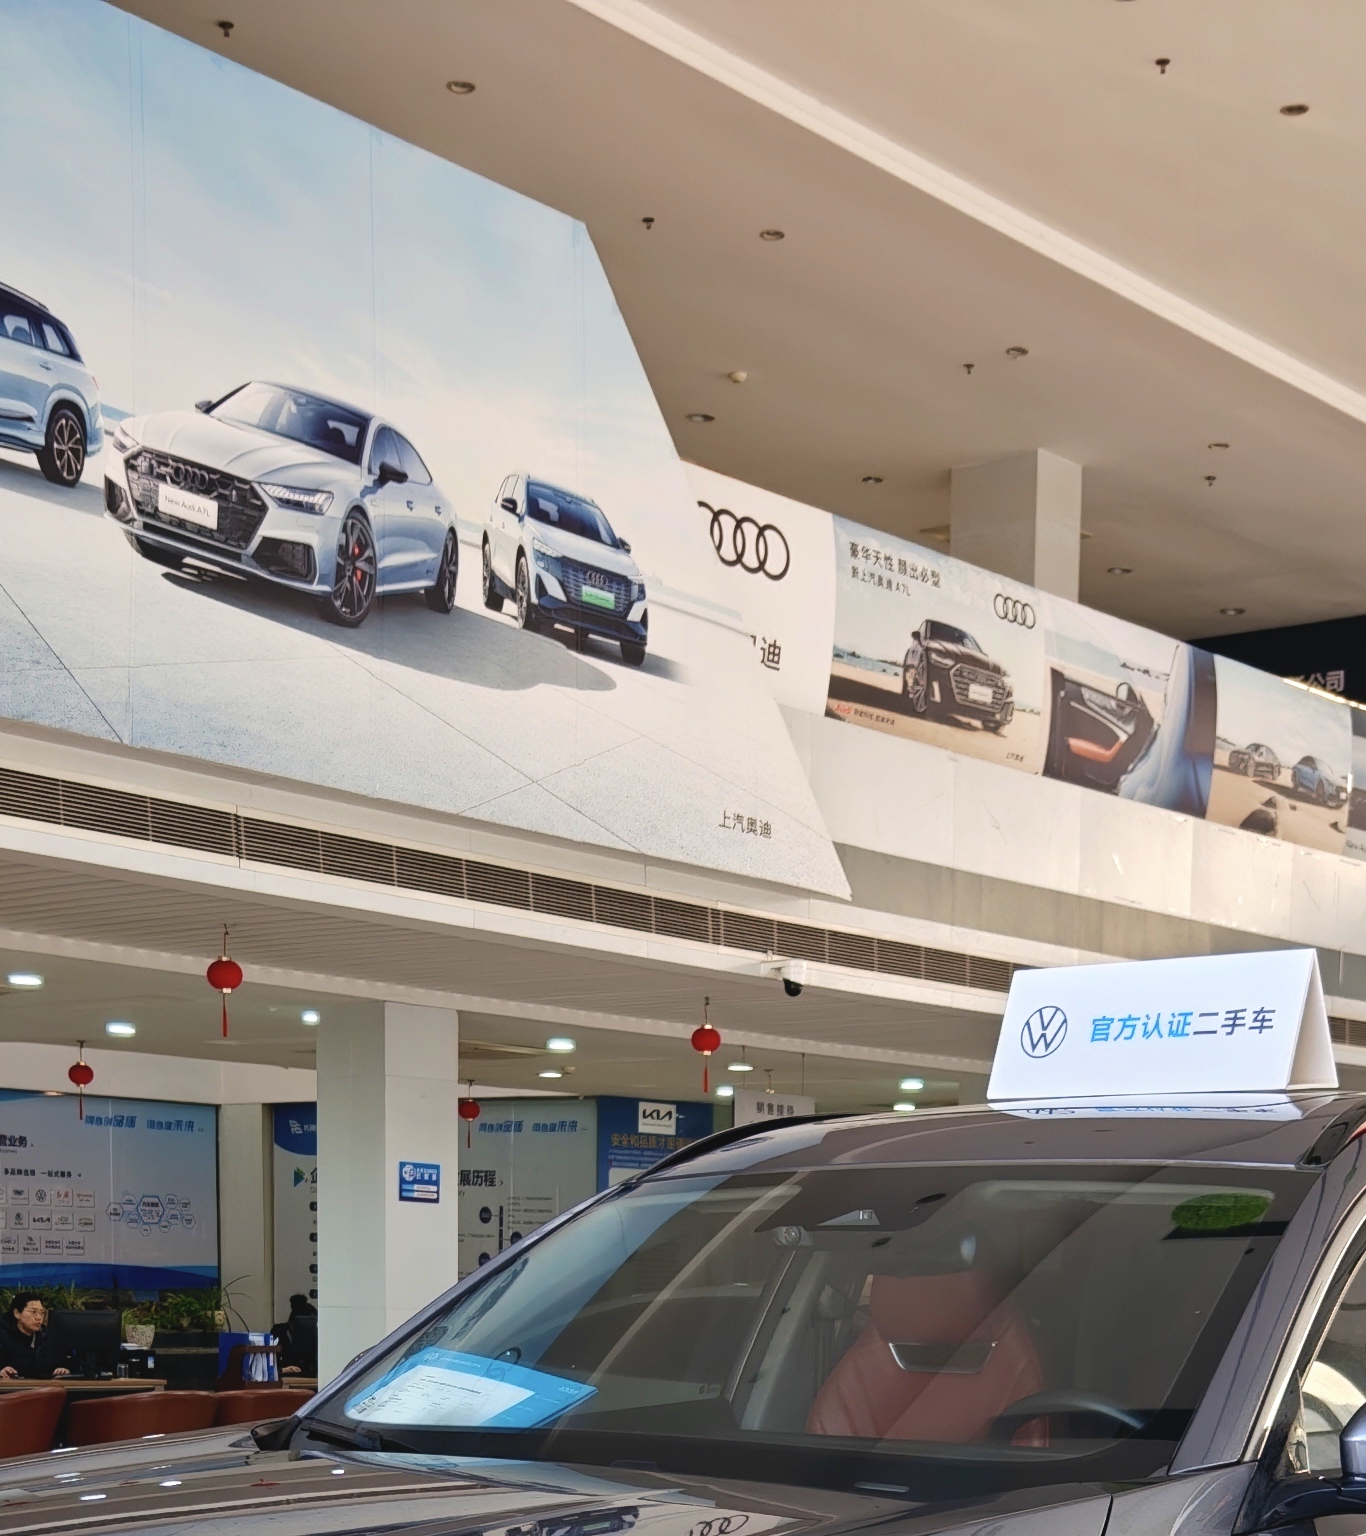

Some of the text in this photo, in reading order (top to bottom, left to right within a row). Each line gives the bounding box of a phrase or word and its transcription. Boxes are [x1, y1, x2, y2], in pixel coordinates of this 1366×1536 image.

[750, 633, 782, 671] 迪
[1295, 670, 1345, 693] 公司
[718, 807, 773, 839] 上汽奥迪
[1089, 1006, 1276, 1043] 官方认证二手车
[642, 1108, 673, 1121] KIA
[457, 1170, 497, 1187] 展历程
